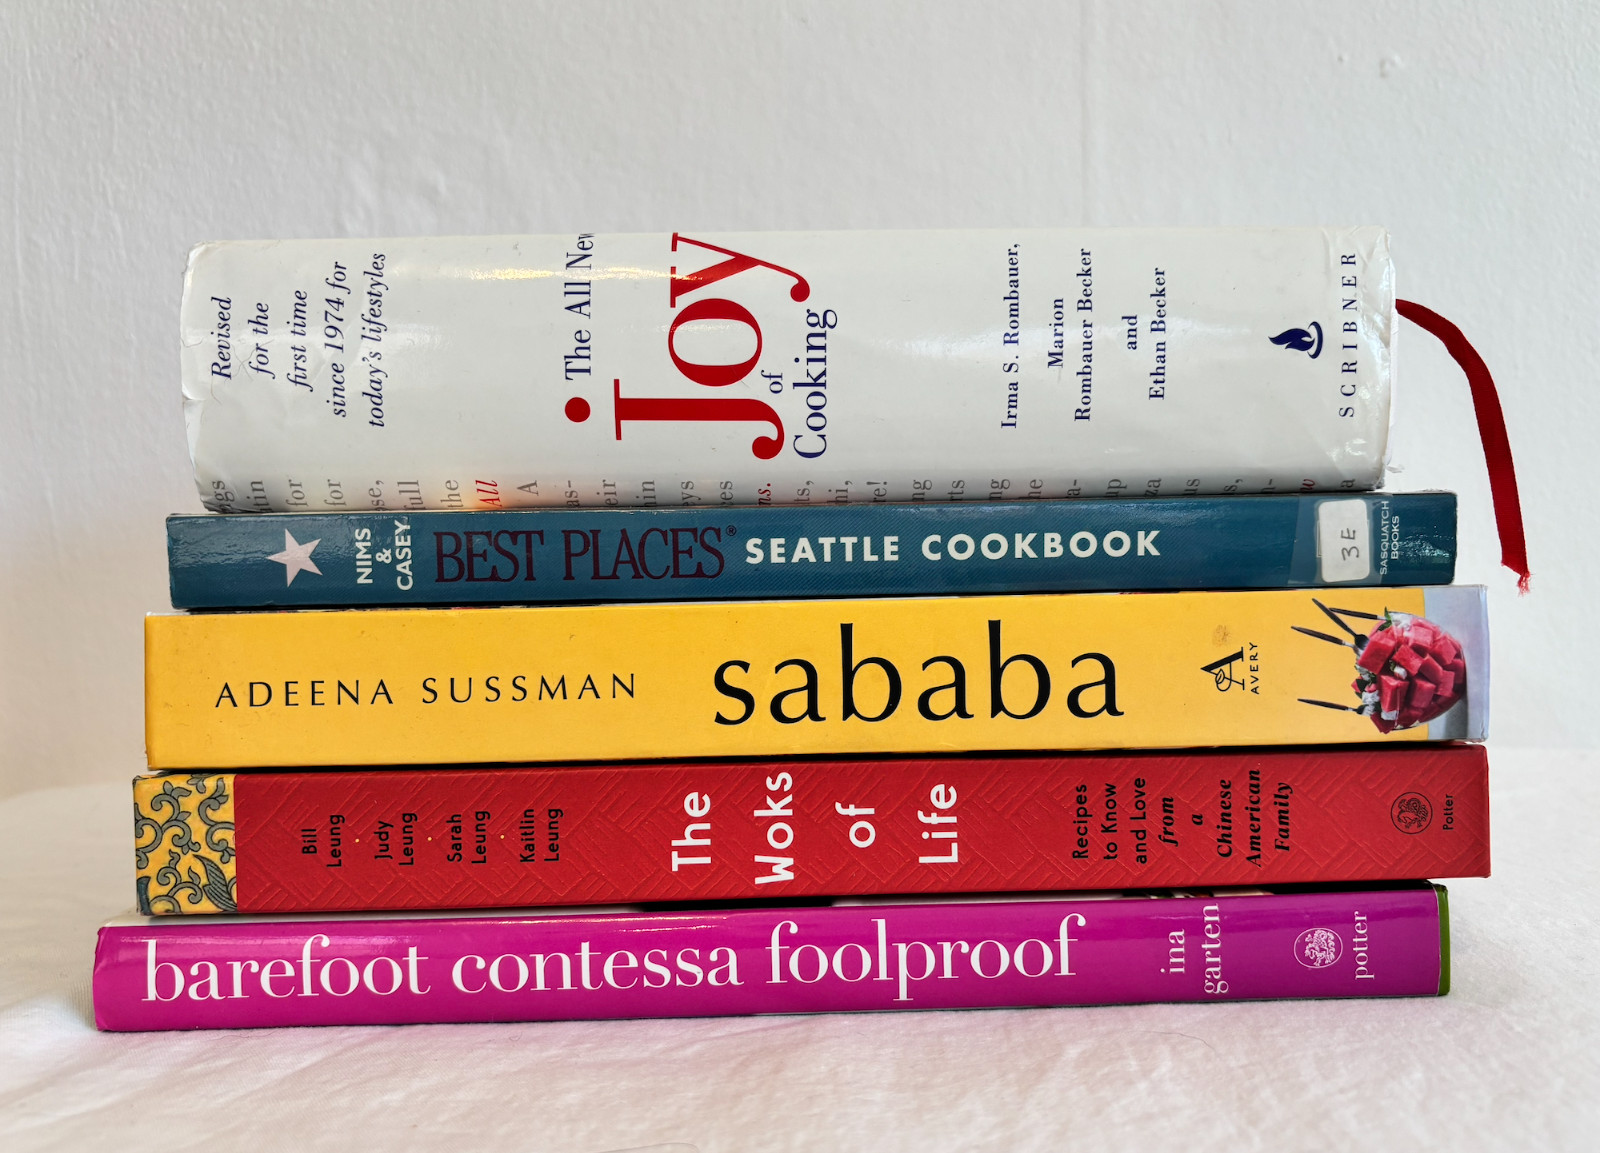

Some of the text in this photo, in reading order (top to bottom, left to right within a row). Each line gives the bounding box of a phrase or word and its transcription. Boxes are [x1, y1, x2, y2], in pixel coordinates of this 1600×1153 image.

[564, 280, 591, 320] All
[211, 296, 232, 380] Revised
[248, 302, 275, 379] for the
[287, 290, 313, 392] first time
[324, 261, 351, 418] since 1974 for
[361, 253, 389, 428] today's lifestyles
[564, 329, 592, 381] The
[1000, 243, 1021, 429] Irma S. Rombauer,
[1047, 298, 1064, 369] Marion
[1074, 248, 1094, 422] Rombauer Becker
[1121, 314, 1138, 351] and
[1149, 267, 1167, 400] Ethan Becker
[1338, 253, 1358, 418] SCRIBNER
[761, 370, 783, 394] of
[792, 309, 838, 459] Cooking
[285, 479, 308, 507] for
[324, 479, 347, 507] for
[440, 479, 463, 508] the
[475, 479, 502, 508] All
[517, 480, 539, 496] A
[356, 527, 373, 585] NIMS
[375, 548, 392, 565] &
[396, 520, 413, 591] CASEY
[433, 529, 544, 583] BEST
[745, 530, 1161, 564] SEATTLE COOKBOOK
[1380, 501, 1390, 575] SASQUATCH
[1391, 516, 1400, 560] BOOKS
[215, 673, 635, 708] ADEENA SUSSMAN
[713, 620, 1125, 725] sababa
[1249, 642, 1259, 694] AVERY
[399, 812, 417, 866] Leung
[446, 813, 462, 862] Sarah
[471, 810, 490, 864] Leung
[519, 808, 535, 863] Kaitlin
[544, 808, 563, 862] Leung
[671, 791, 711, 871] The
[753, 772, 794, 885] Woks
[834, 801, 876, 848] of
[917, 783, 958, 863] Life
[1072, 783, 1092, 859] Recipes
[1100, 782, 1118, 860] to Know
[1129, 777, 1147, 864] and Love
[1158, 796, 1178, 847] from
[1191, 813, 1203, 826] a
[1216, 779, 1232, 858] Chinese
[1244, 769, 1262, 868] American
[1274, 782, 1293, 852] Family
[1443, 794, 1454, 830] Potter
[301, 828, 317, 855] Bill
[326, 814, 345, 867] Leung
[374, 820, 394, 860] Judy
[141, 912, 1087, 1002] barefoot contessa foolproof
[1160, 928, 1185, 975] ina
[1201, 903, 1229, 995] garten
[1352, 910, 1375, 980] potter
